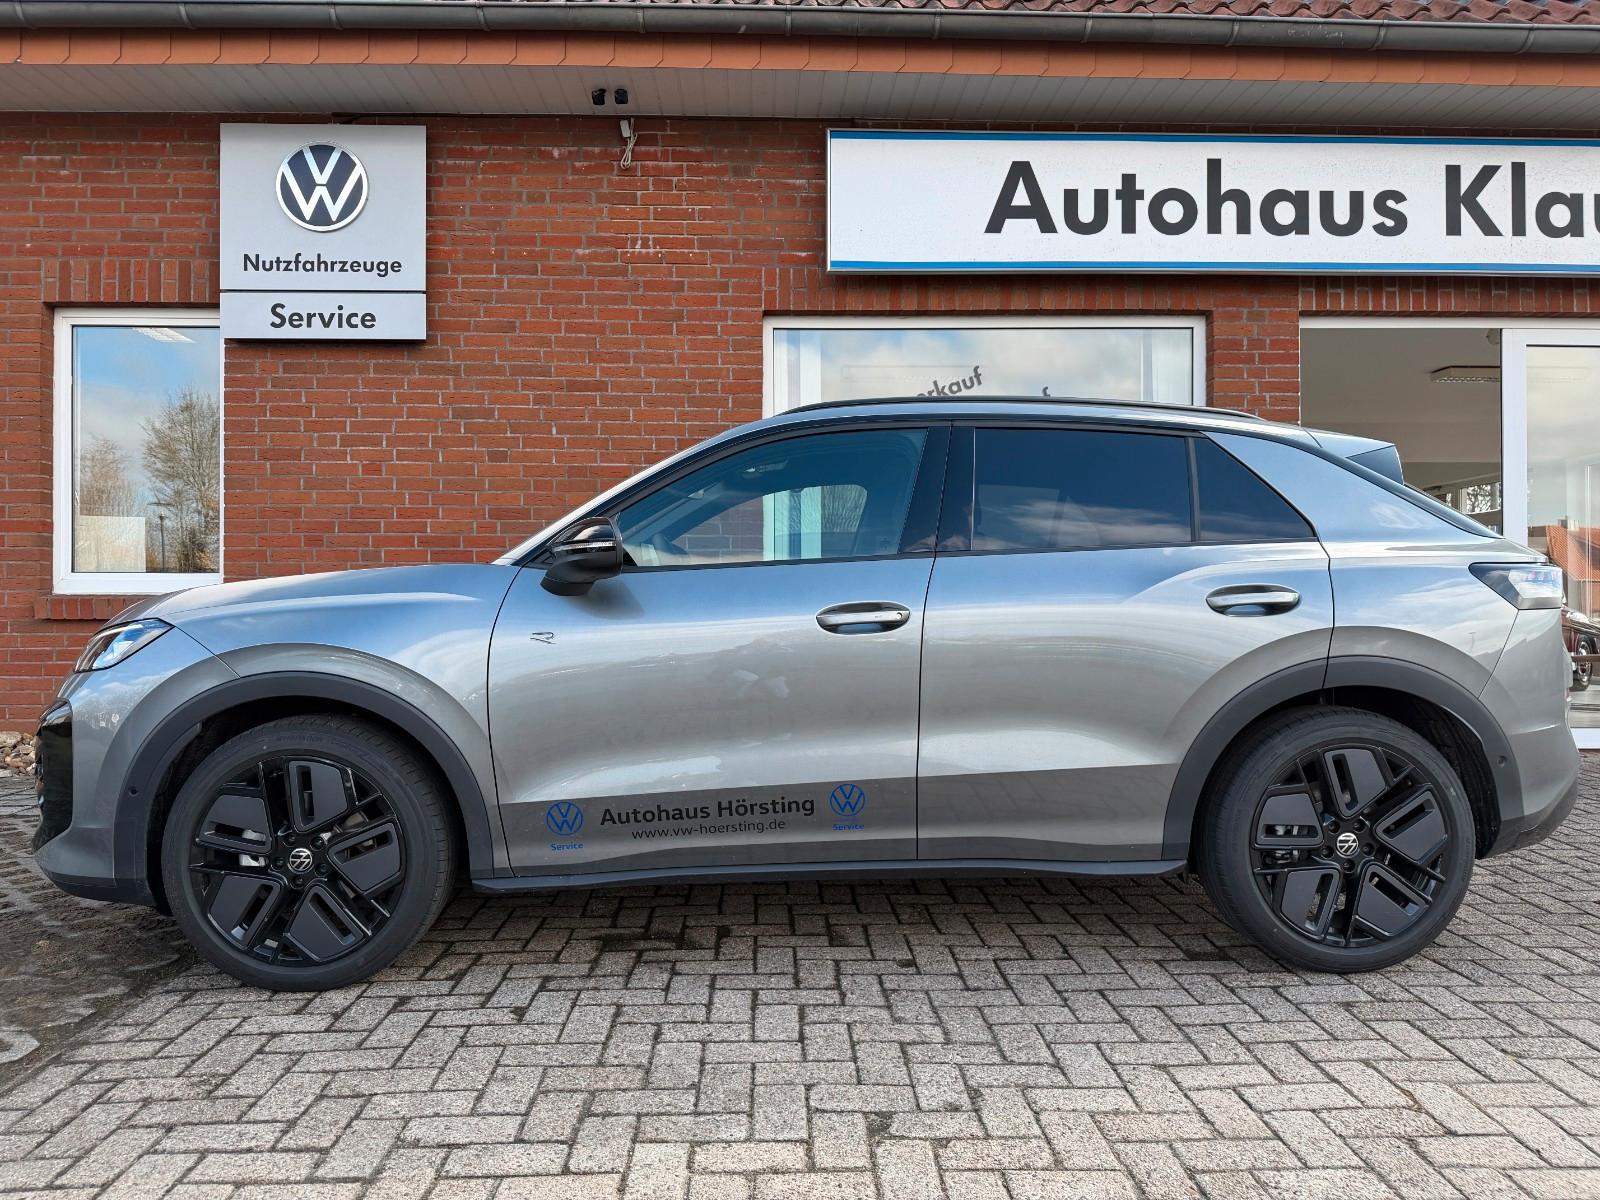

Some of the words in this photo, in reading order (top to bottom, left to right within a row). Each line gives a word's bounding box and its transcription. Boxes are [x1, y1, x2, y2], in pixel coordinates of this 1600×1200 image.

[984, 158, 1408, 236] Autohaus
[1445, 162, 1600, 239] Kla
[243, 253, 402, 277] Nutzfahrzeuge
[270, 303, 376, 329] Service
[600, 804, 710, 826] Autohaus
[717, 796, 815, 818] Hörsting
[631, 819, 786, 840] www.vw-hoersting.de
[832, 823, 865, 831] Service
[550, 842, 584, 851] Service
